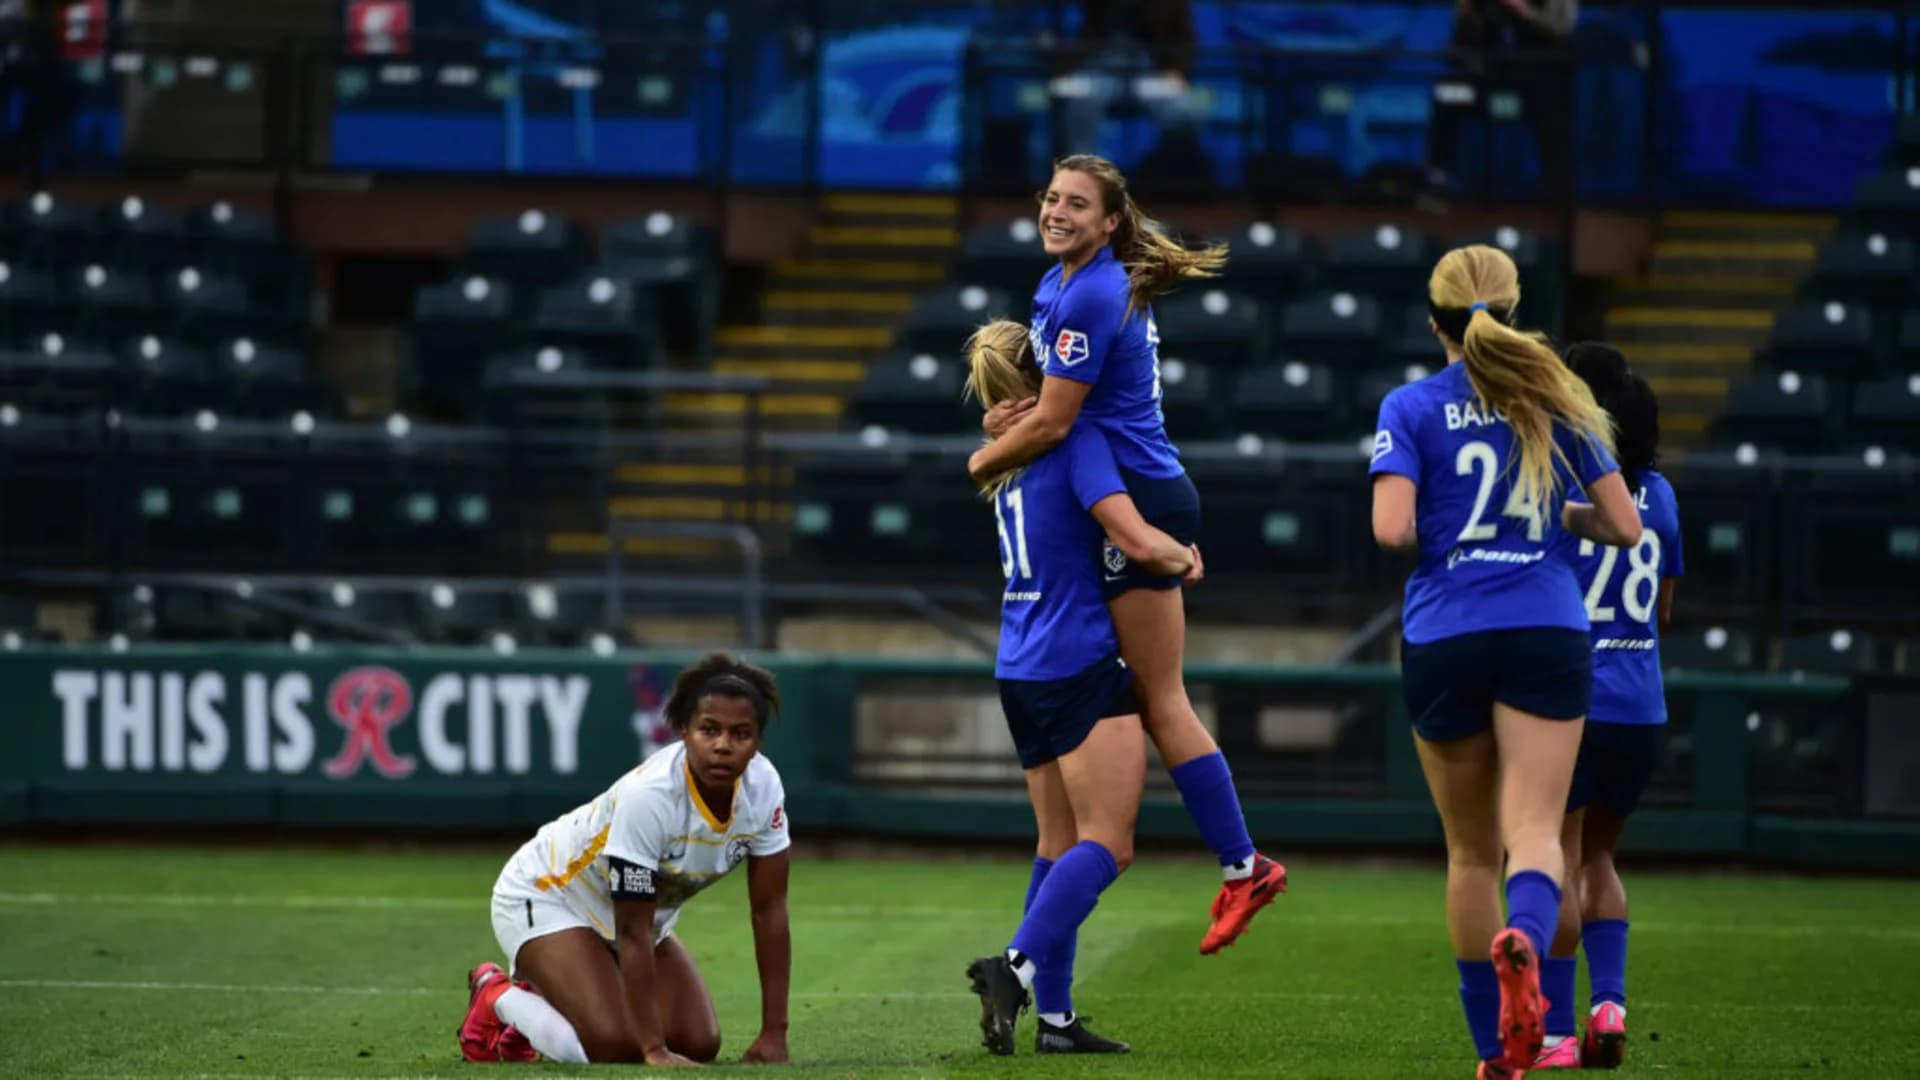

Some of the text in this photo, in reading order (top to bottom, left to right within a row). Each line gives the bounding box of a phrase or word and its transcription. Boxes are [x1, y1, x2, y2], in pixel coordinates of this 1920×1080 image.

[1456, 441, 1543, 542] 24
[1579, 527, 1660, 622] 28
[1595, 639, 1654, 650] BOEING
[53, 670, 229, 770] THIS
[243, 672, 315, 772] IS
[418, 673, 589, 772] CITY
